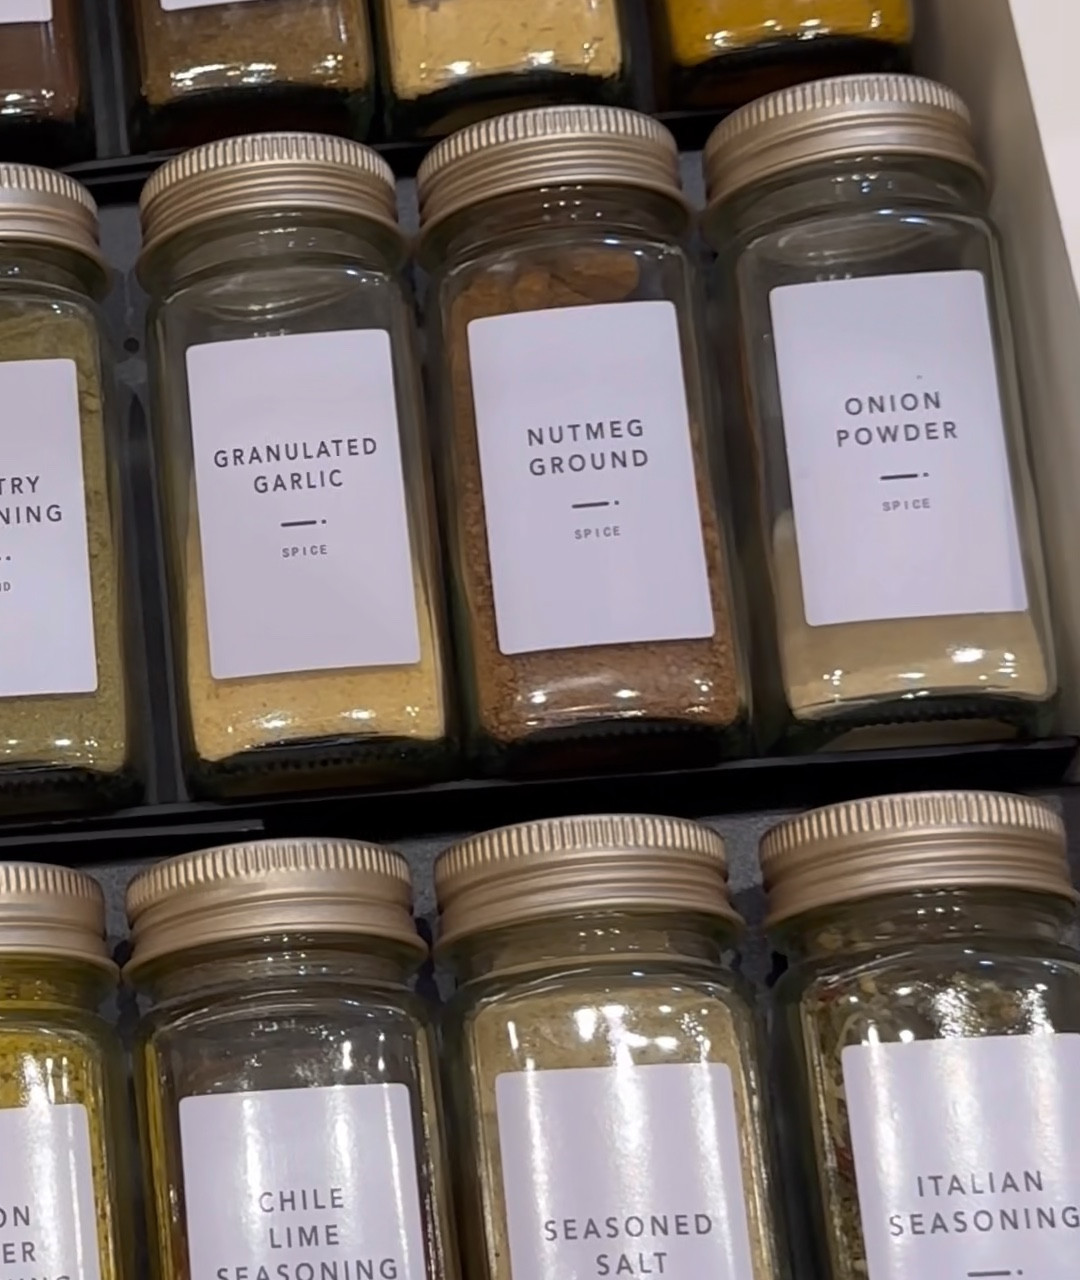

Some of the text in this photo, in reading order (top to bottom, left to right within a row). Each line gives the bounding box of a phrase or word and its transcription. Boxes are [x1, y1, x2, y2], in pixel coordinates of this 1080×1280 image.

[844, 391, 941, 416] ONION
[527, 418, 644, 447] NUTMEG
[836, 420, 958, 448] POWDER
[213, 437, 377, 469] GRANULATED
[529, 449, 649, 477] GROUND
[253, 468, 344, 494] GARLIC
[881, 497, 931, 512] SPICE
[574, 525, 621, 541] SPICE
[281, 543, 328, 559] SPICE
[916, 1170, 1044, 1198] ITALIAN
[257, 1187, 345, 1214] CHILE
[543, 1213, 713, 1242] SEASONED
[889, 1205, 1080, 1238] SEASONING
[268, 1223, 340, 1249] LIME
[595, 1251, 668, 1277] SALT
